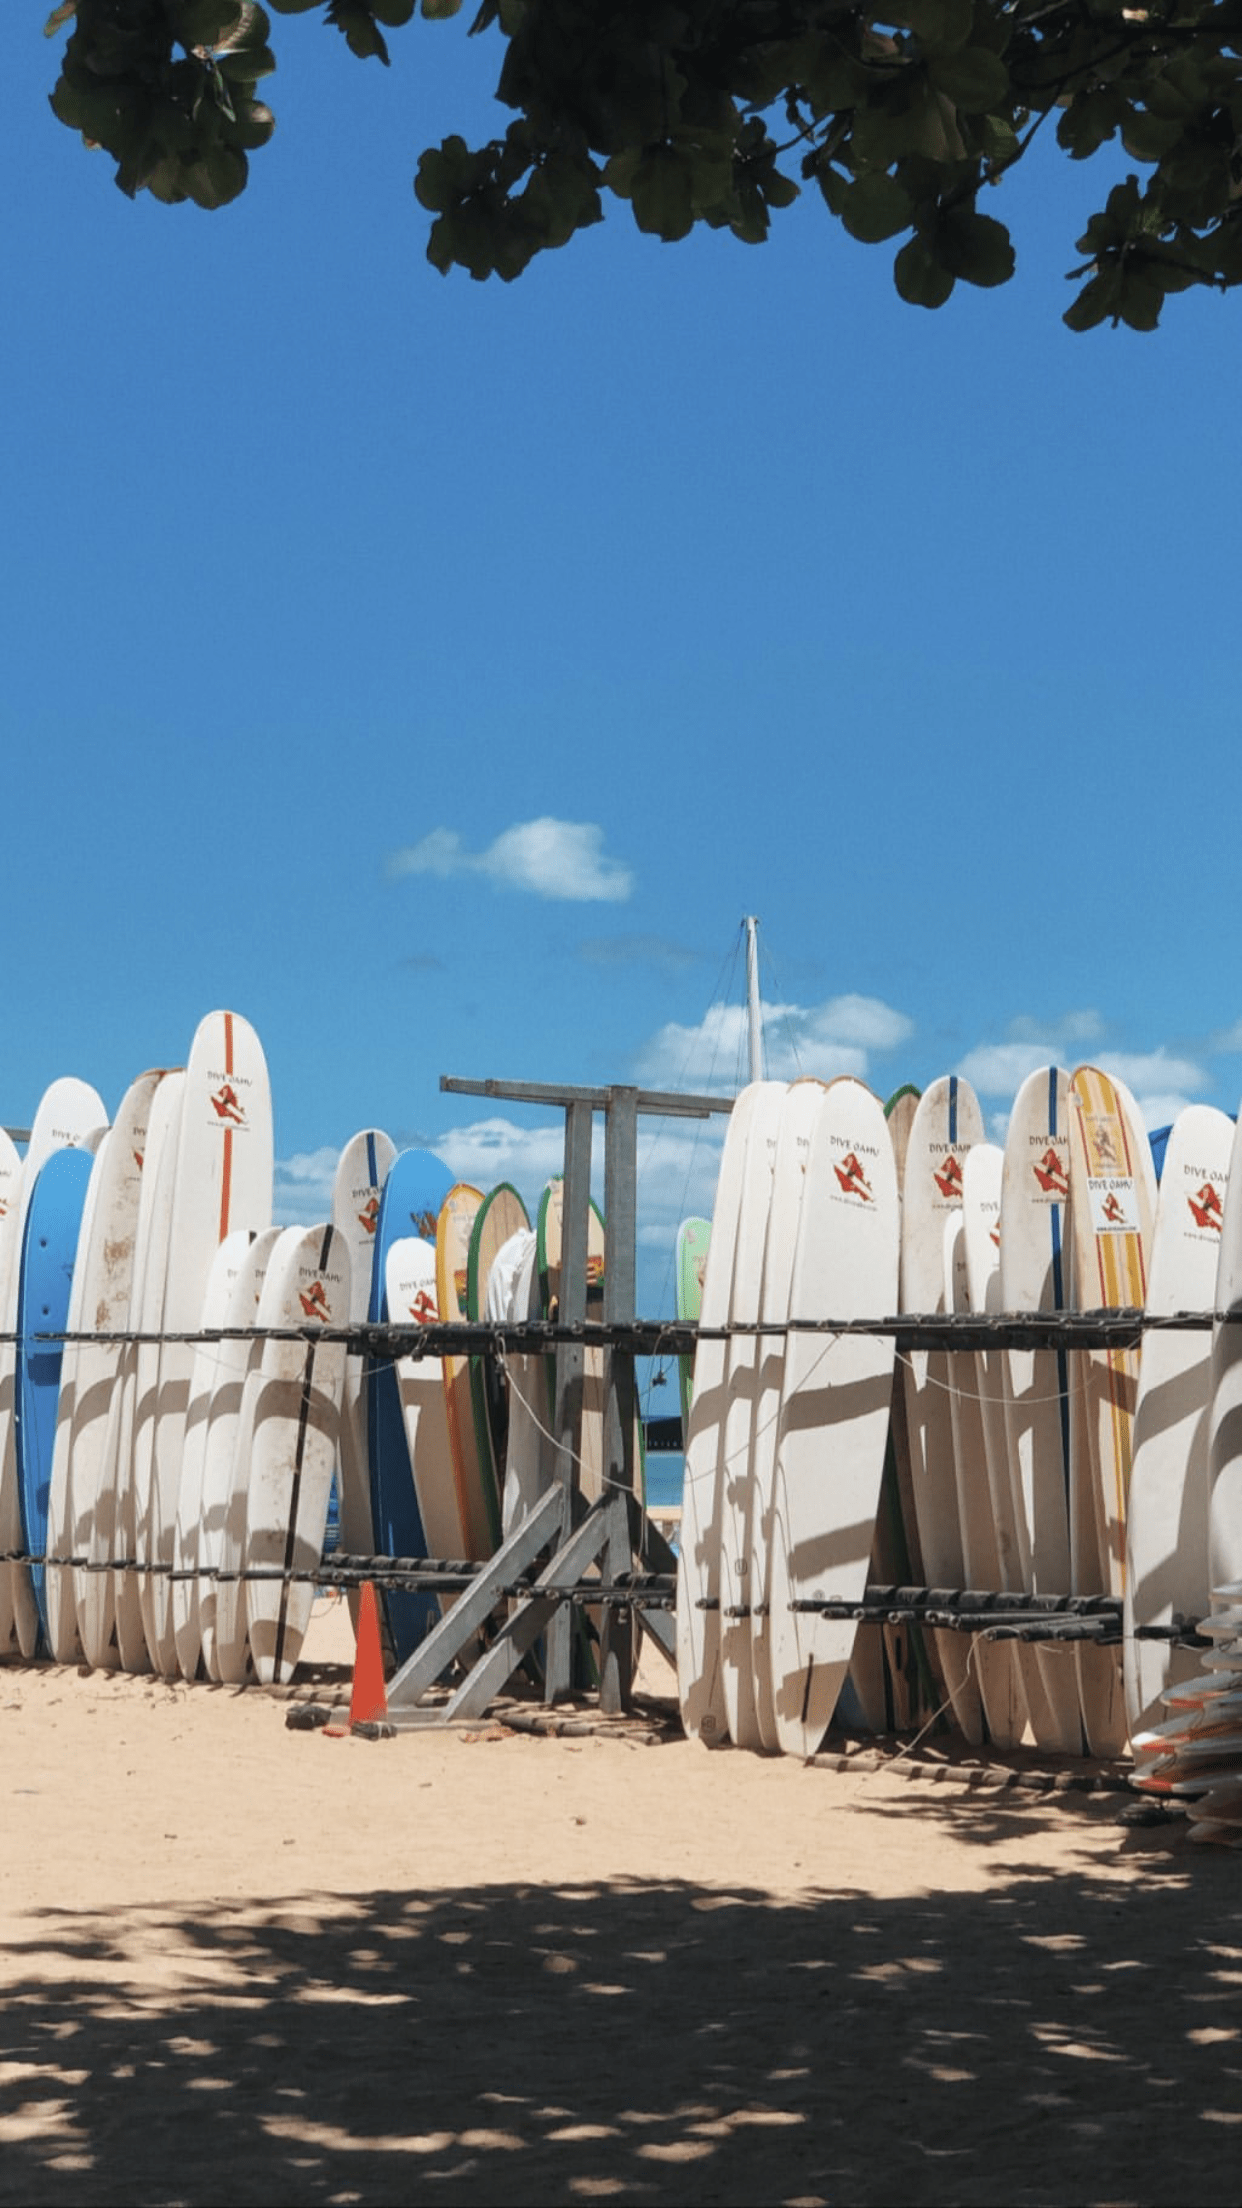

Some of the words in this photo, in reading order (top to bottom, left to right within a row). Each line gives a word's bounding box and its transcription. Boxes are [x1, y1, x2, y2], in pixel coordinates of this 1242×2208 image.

[830, 1136, 850, 1148] DIVE
[853, 1143, 879, 1156] OAHU
[1029, 1135, 1049, 1146] DIVE
[1050, 1135, 1069, 1146] OAH
[929, 1143, 949, 1154] DIVE
[951, 1143, 971, 1153] OAH
[1184, 1164, 1206, 1179] DIVE
[1209, 1170, 1231, 1183] OAH
[1088, 1180, 1108, 1191] DIVE
[1109, 1180, 1132, 1191] OAHU
[352, 1187, 371, 1198] DIVE
[299, 1267, 317, 1278] DIVE
